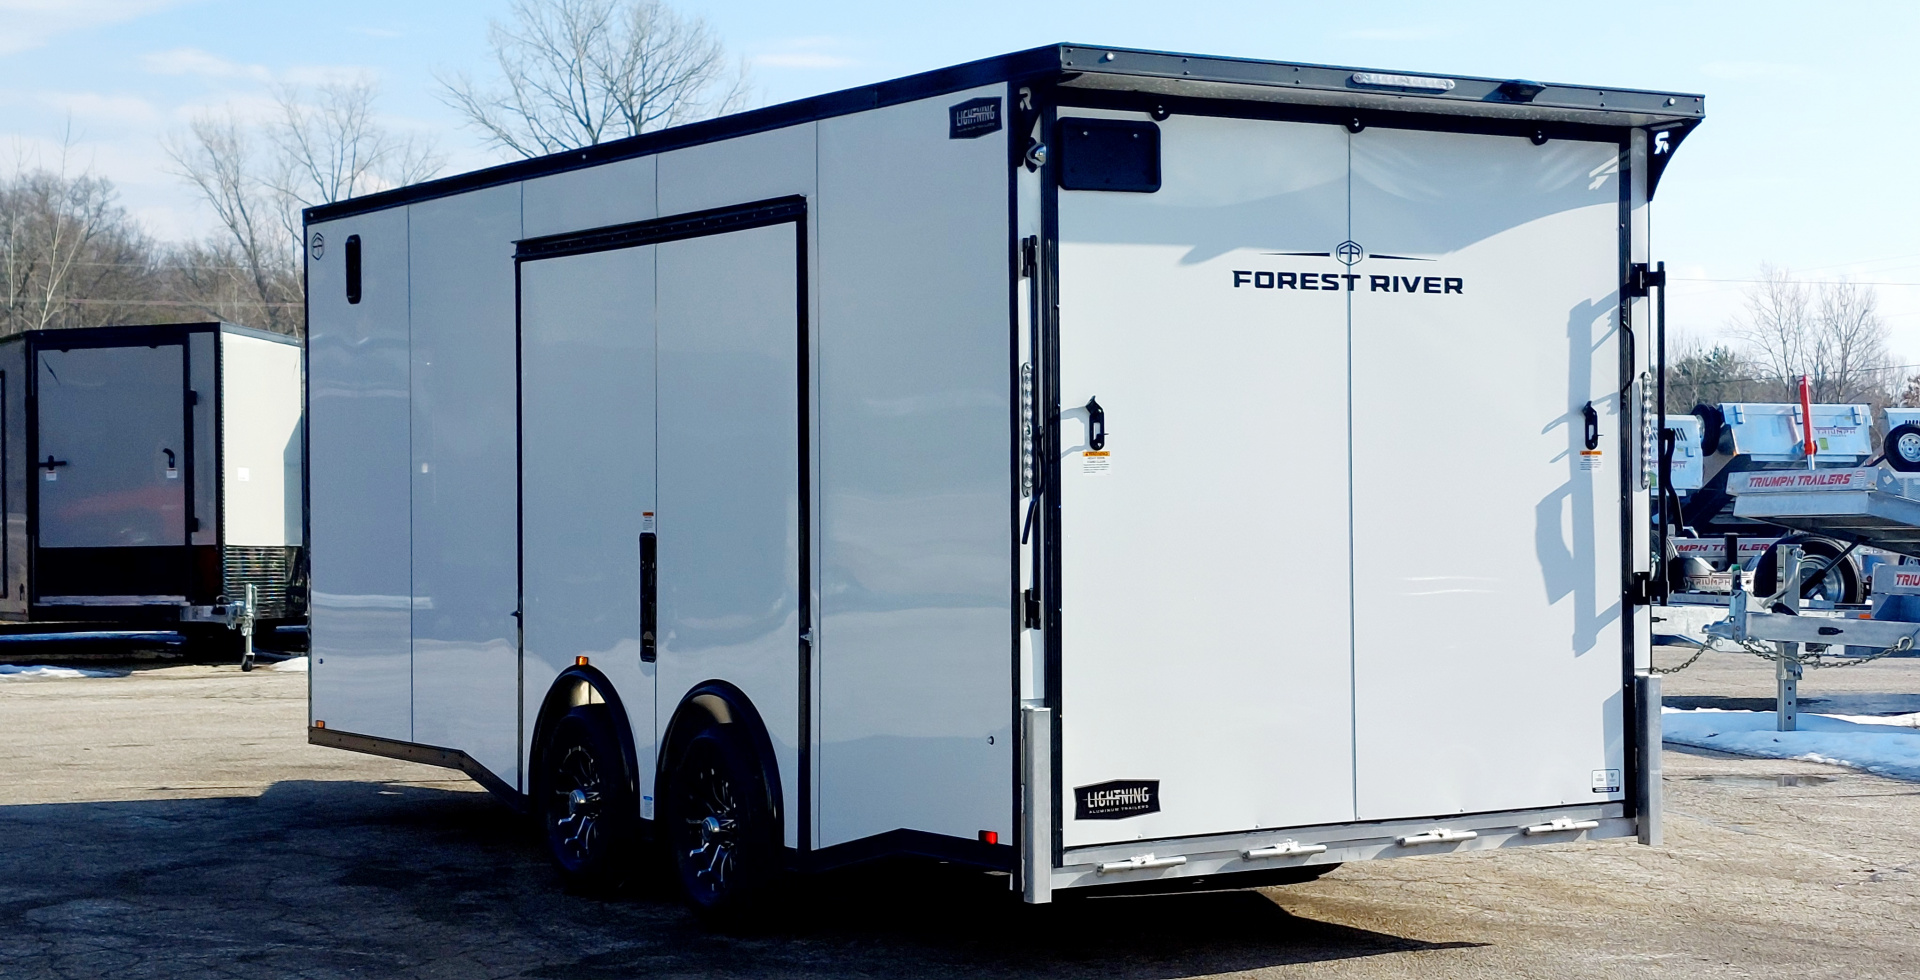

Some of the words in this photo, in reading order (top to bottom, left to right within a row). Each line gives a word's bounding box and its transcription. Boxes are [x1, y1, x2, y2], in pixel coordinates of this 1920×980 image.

[956, 104, 995, 126] LIGHTNING
[1232, 270, 1361, 292] FOREST
[1369, 274, 1464, 294] RIVER
[1749, 476, 1795, 488] TRIUMPH
[1798, 474, 1852, 486] TRAILERS
[1088, 787, 1149, 808] LIGHTNING
